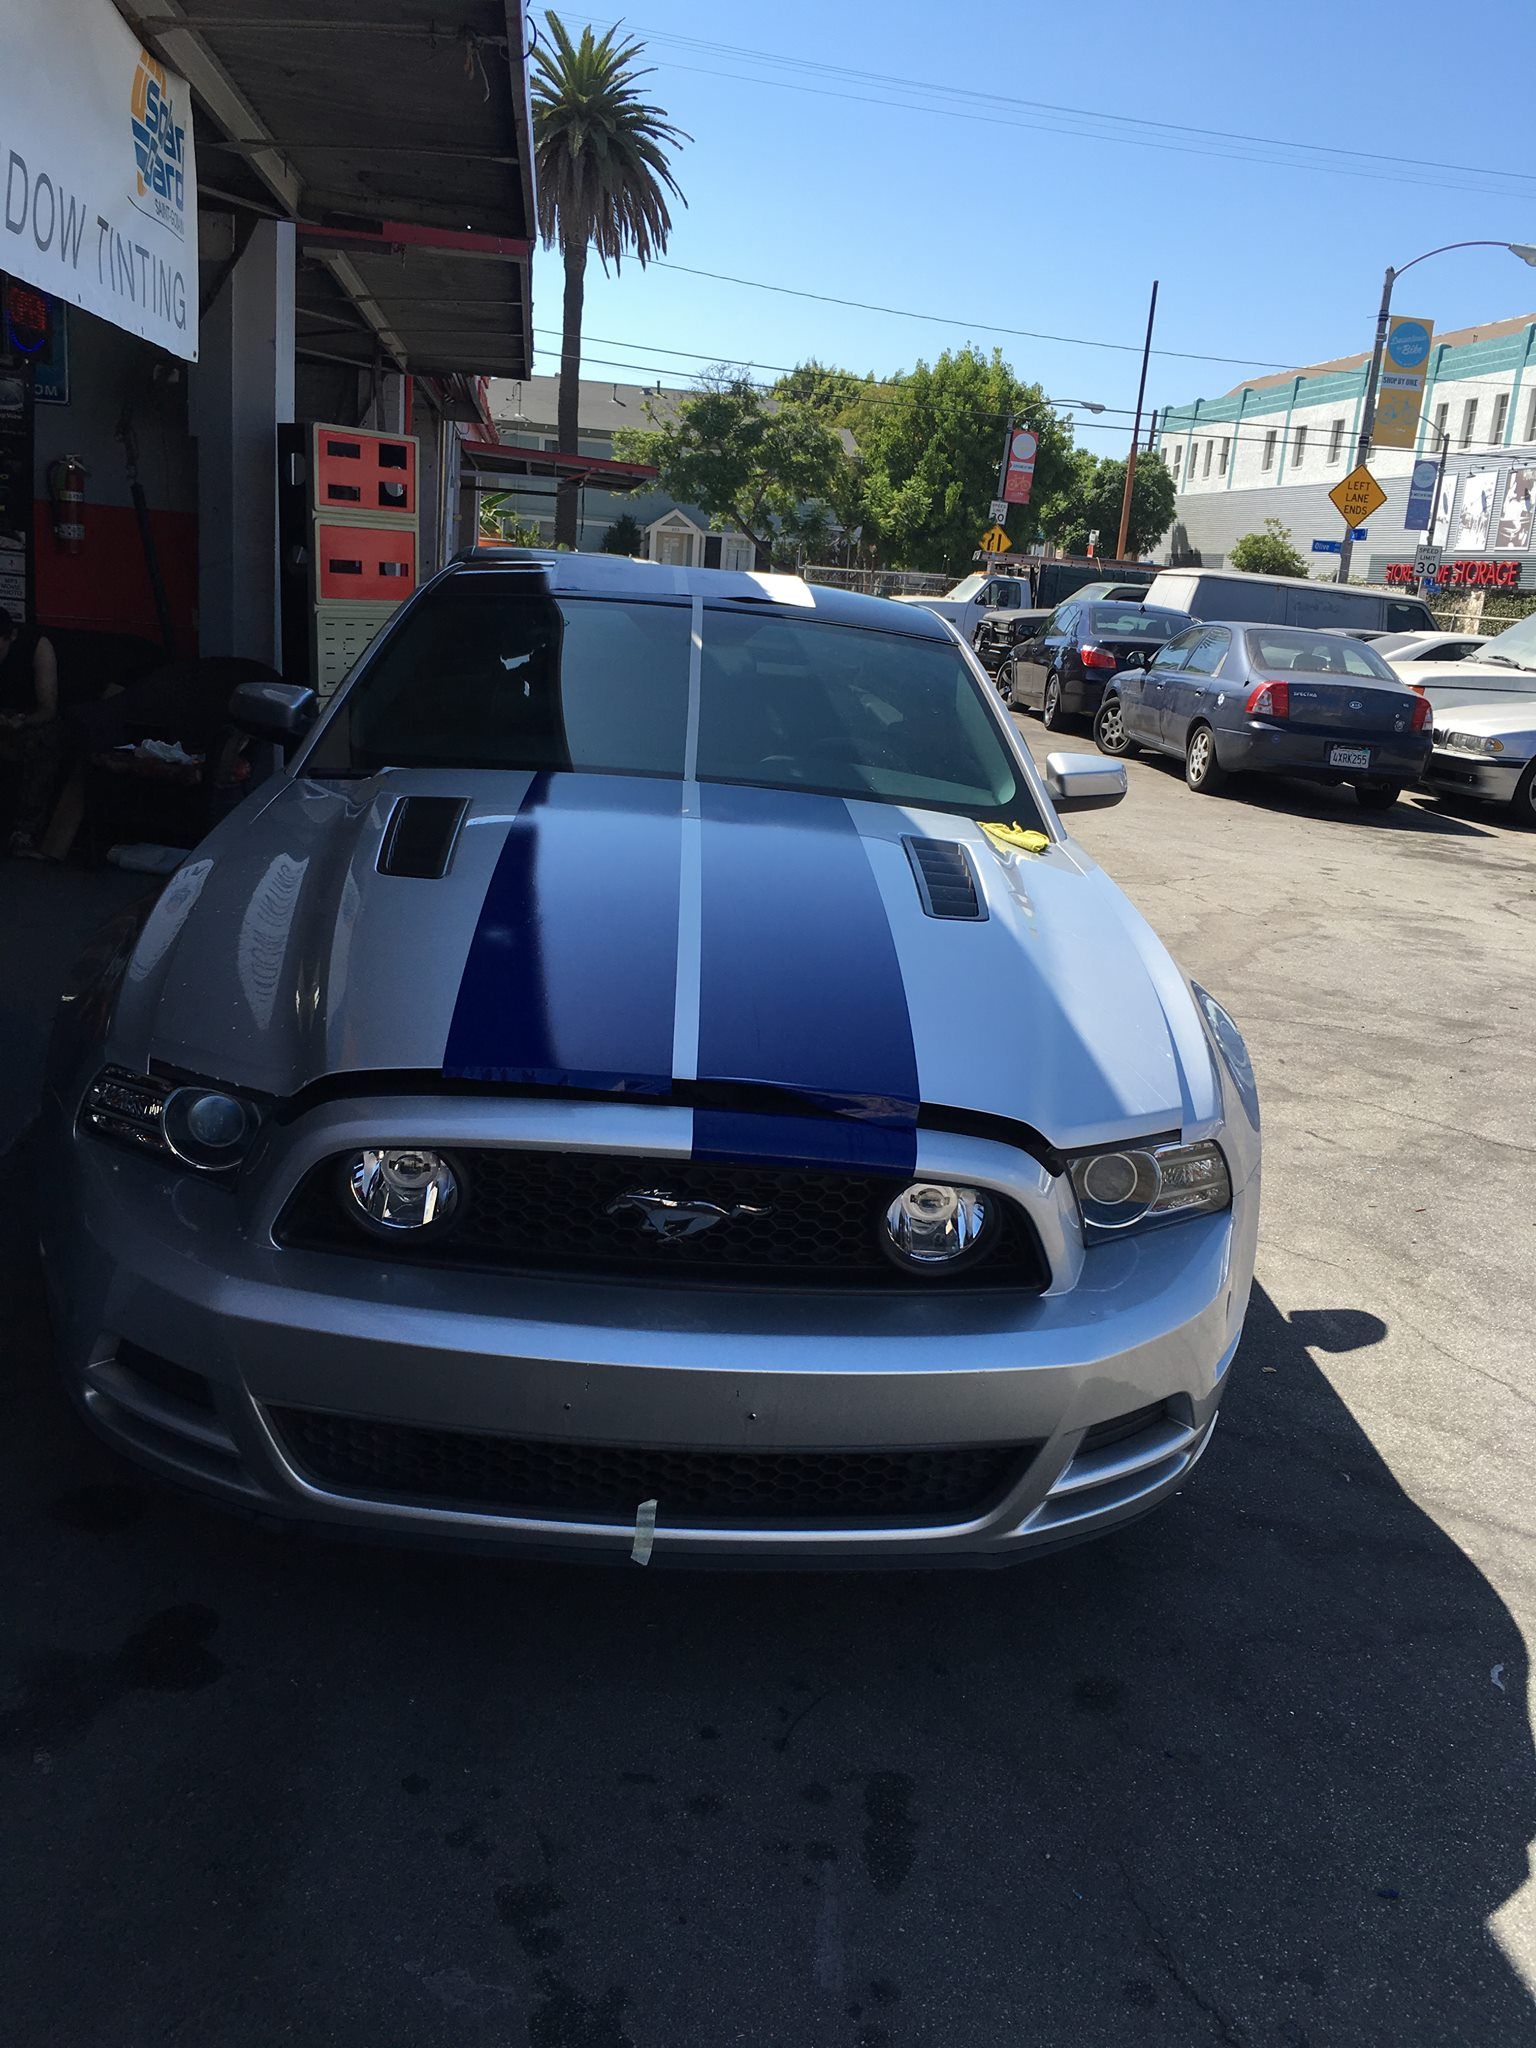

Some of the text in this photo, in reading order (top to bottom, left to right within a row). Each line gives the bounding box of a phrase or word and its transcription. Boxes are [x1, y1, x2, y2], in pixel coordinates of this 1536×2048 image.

[96, 214, 187, 331] TINTING
[1383, 376, 1397, 385] SHOP
[1347, 481, 1371, 491] LEFT
[1345, 493, 1370, 504] LANE
[1343, 504, 1368, 516] ENDS
[1314, 542, 1330, 551] Olive
[1419, 547, 1440, 555] SPEED
[1415, 561, 1437, 575] 30
[1452, 560, 1518, 586] STORAGE
[1332, 753, 1367, 766] 4XRK255
